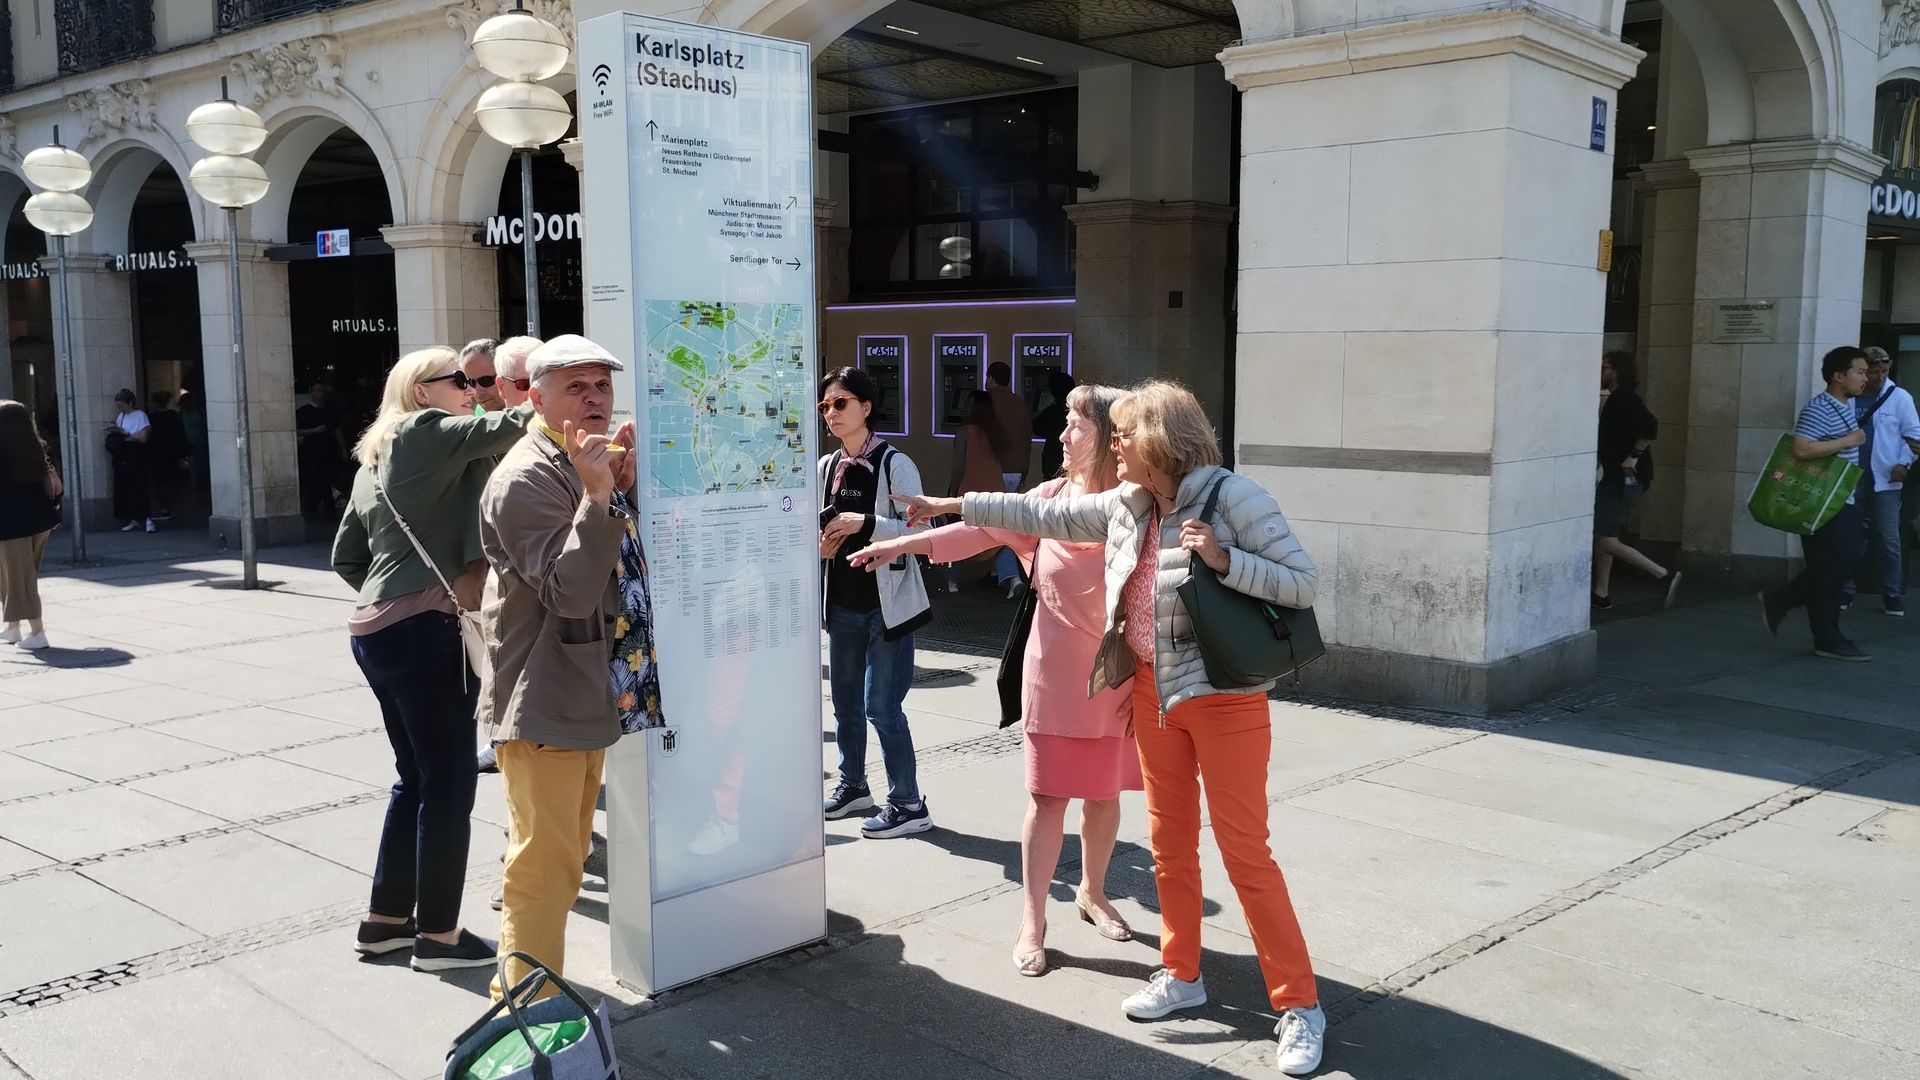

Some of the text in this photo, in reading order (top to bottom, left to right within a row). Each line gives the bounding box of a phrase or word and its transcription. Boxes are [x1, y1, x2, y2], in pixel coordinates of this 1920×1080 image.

[636, 33, 744, 69] Karlsplatz
[637, 62, 737, 98] (Stachus)
[593, 99, 612, 109] M-WLAN
[1595, 103, 1605, 125] 10
[661, 135, 708, 147] Marienplatz
[662, 148, 682, 156] Neues
[683, 150, 708, 159] Rathaus
[713, 153, 751, 163] Glockenspiel
[661, 157, 702, 167] Frauenkirche
[673, 168, 698, 176] Michael
[723, 198, 782, 210] Viktualienmarkt
[708, 209, 782, 221] Münchner Stadtmuseum
[725, 220, 782, 230] Jüdisches Museum
[720, 228, 749, 238] Synagoge
[730, 254, 782, 265] Sendlinger Tor
[870, 346, 898, 356] CASH
[945, 345, 973, 356] CASH
[1026, 345, 1056, 356] CASH
